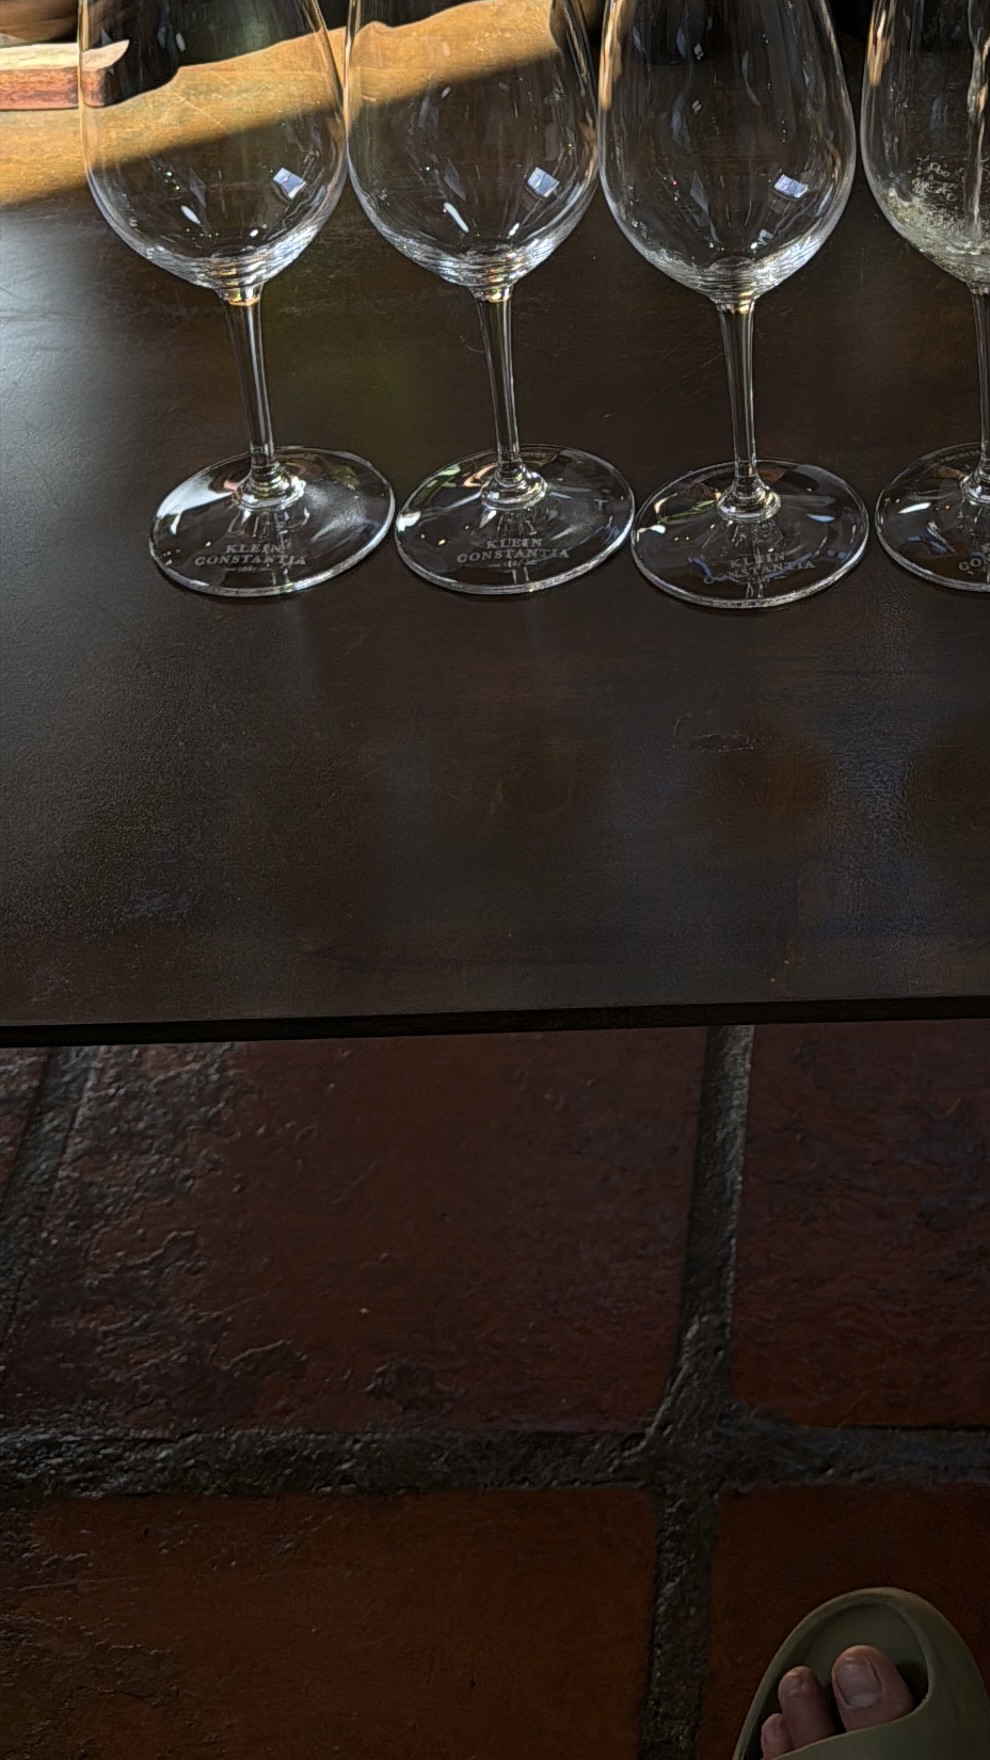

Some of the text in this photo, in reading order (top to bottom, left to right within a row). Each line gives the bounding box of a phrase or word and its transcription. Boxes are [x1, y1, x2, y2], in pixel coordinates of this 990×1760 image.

[225, 543, 282, 554] KLEIN
[486, 538, 543, 549] KLEIN
[194, 554, 306, 566] CONSTANTIA
[457, 548, 569, 563] CONSTANTIA
